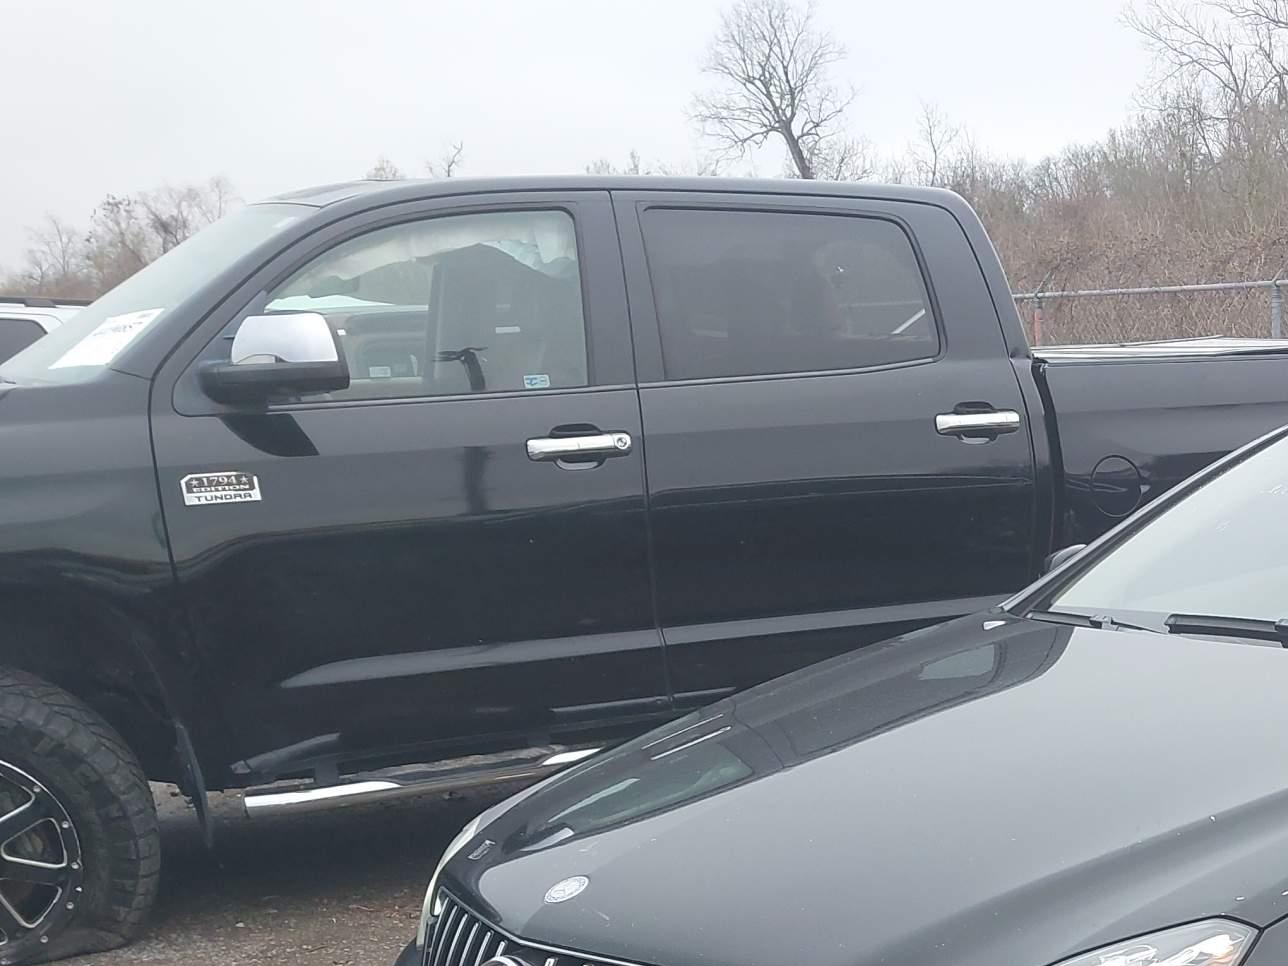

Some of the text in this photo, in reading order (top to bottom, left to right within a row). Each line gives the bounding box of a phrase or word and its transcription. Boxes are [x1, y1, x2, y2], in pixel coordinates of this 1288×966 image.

[202, 475, 237, 487] 1794
[192, 484, 250, 493] EDITION
[194, 492, 253, 503] TUNDRA
